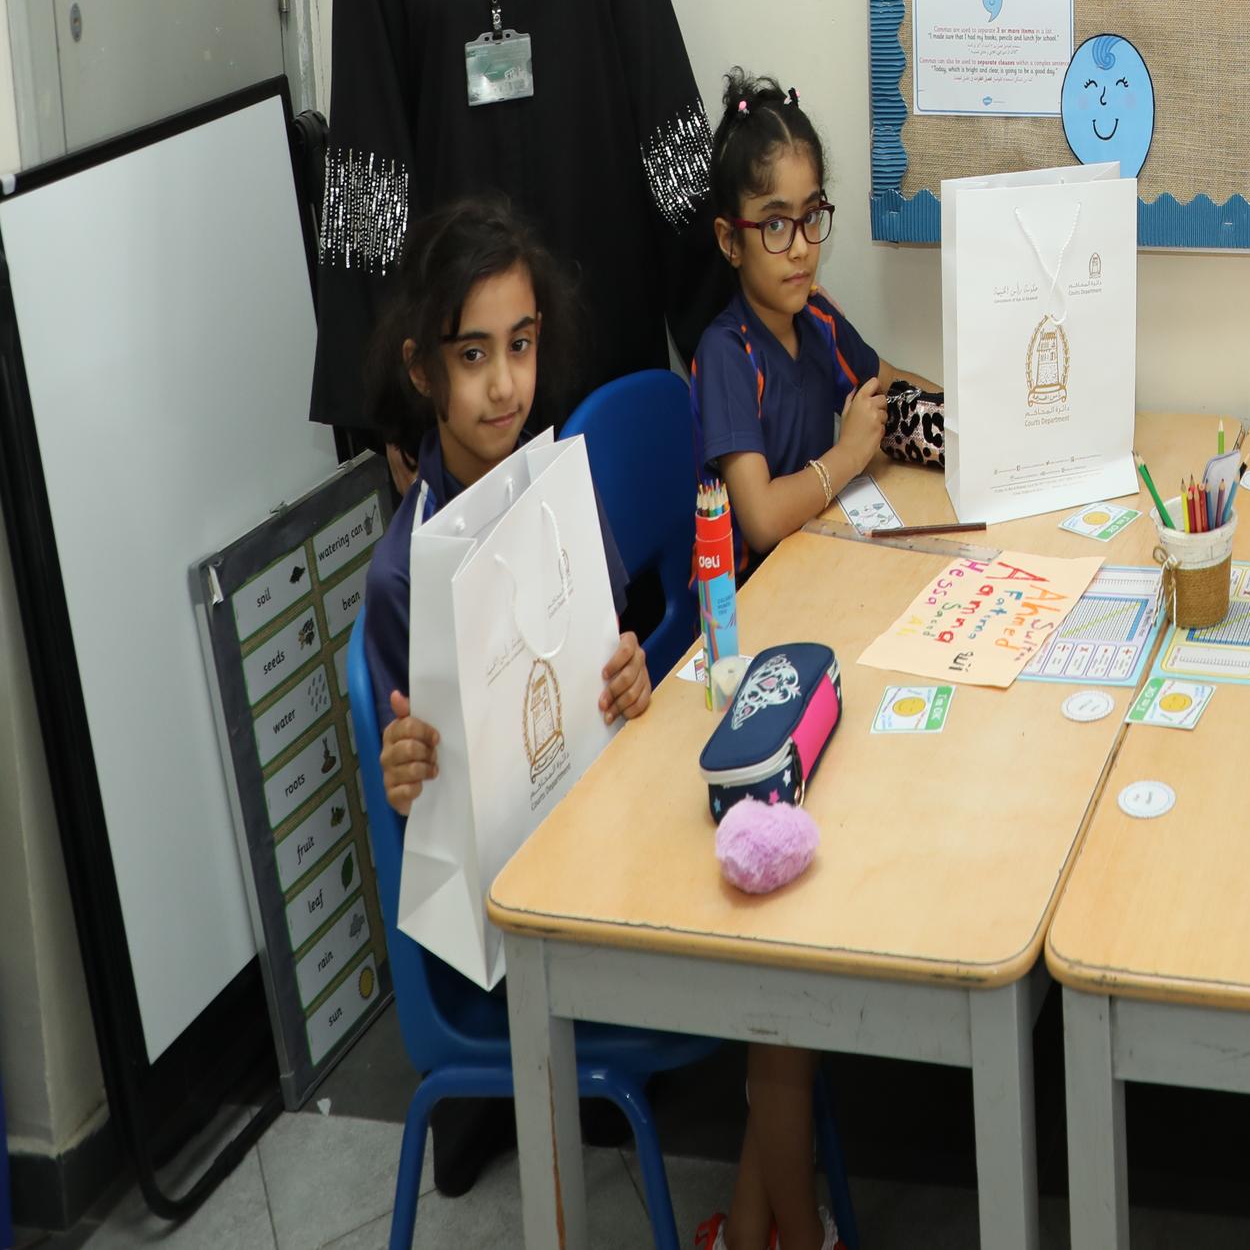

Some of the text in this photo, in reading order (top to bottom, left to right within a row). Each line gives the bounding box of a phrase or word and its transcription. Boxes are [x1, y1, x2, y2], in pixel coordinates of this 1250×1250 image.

[1041, 415, 1069, 426] Department
[317, 523, 364, 562] watering can
[925, 558, 990, 606] Hessa
[256, 587, 272, 608] soil
[341, 592, 361, 612] bean
[934, 560, 1050, 644] Aamna
[994, 583, 1069, 652] Ahmed
[263, 650, 286, 675] seeds
[272, 709, 297, 736] water
[284, 773, 306, 798] roots
[296, 836, 316, 865] fruit
[307, 889, 325, 915] leaf
[317, 949, 334, 974] rain
[328, 1007, 343, 1028] sun
